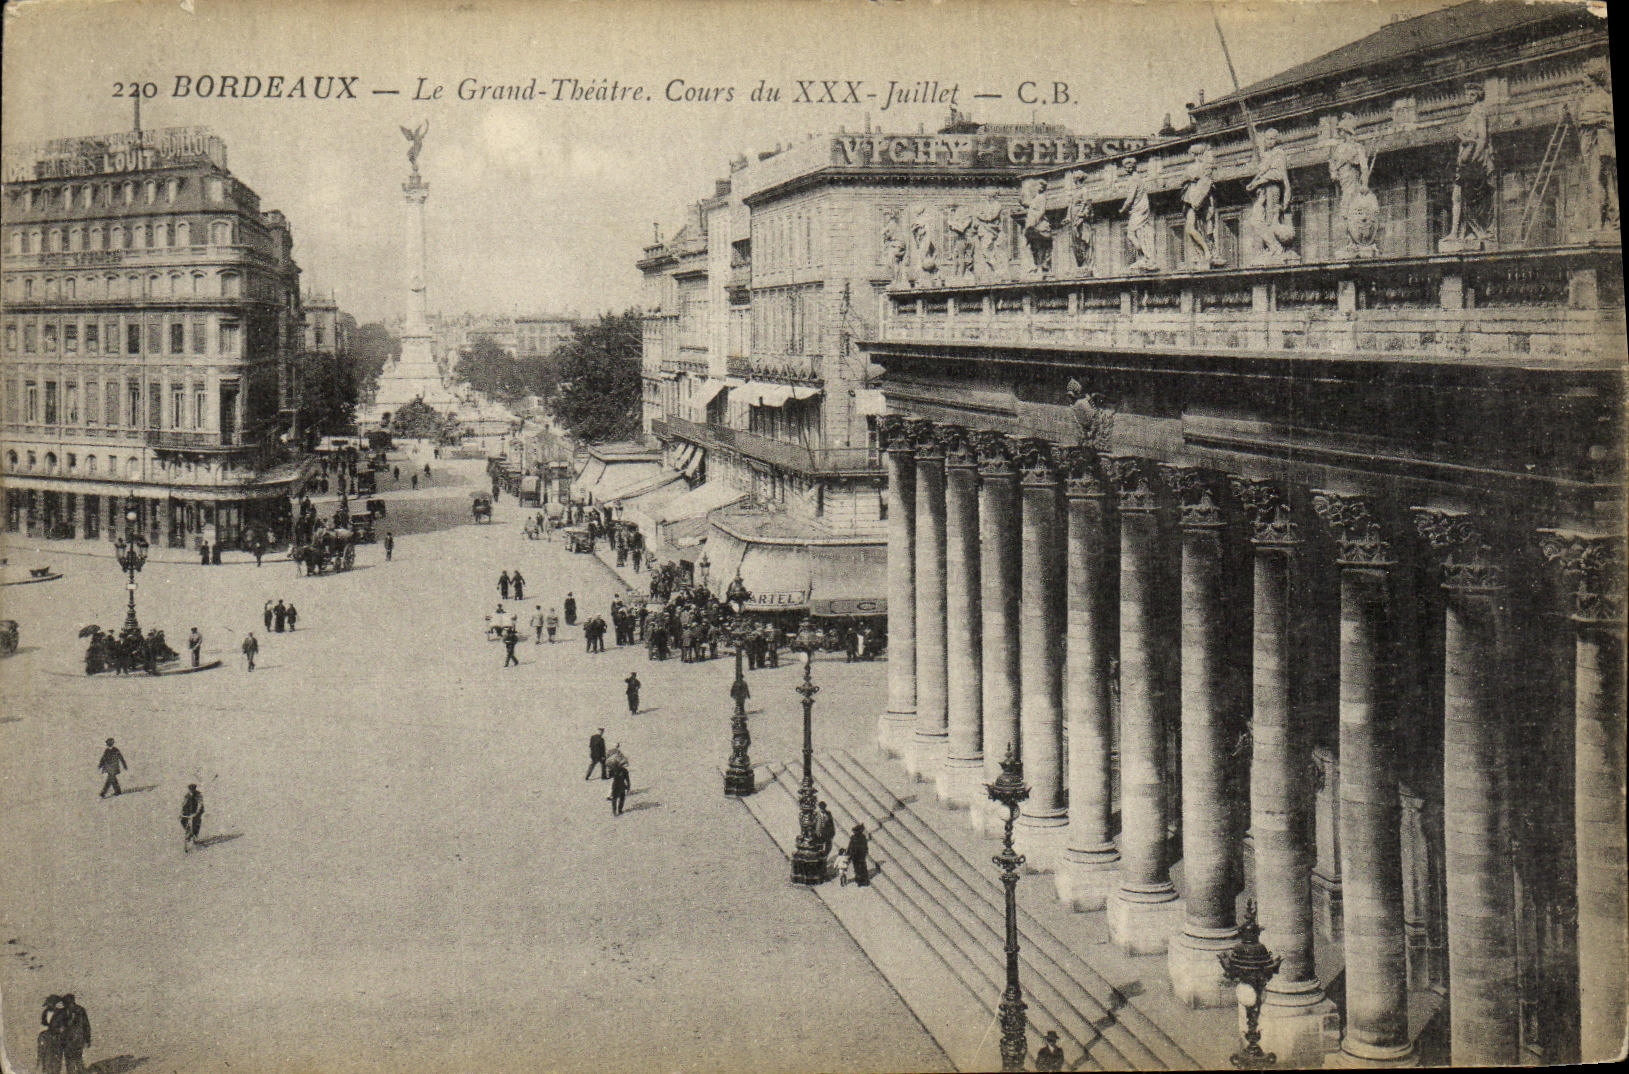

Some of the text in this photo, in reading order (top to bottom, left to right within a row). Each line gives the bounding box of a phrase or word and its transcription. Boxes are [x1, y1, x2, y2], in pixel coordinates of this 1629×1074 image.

[103, 150, 155, 173] LOUIT
[837, 136, 974, 168] VICHY
[749, 593, 795, 605] ARTEL
